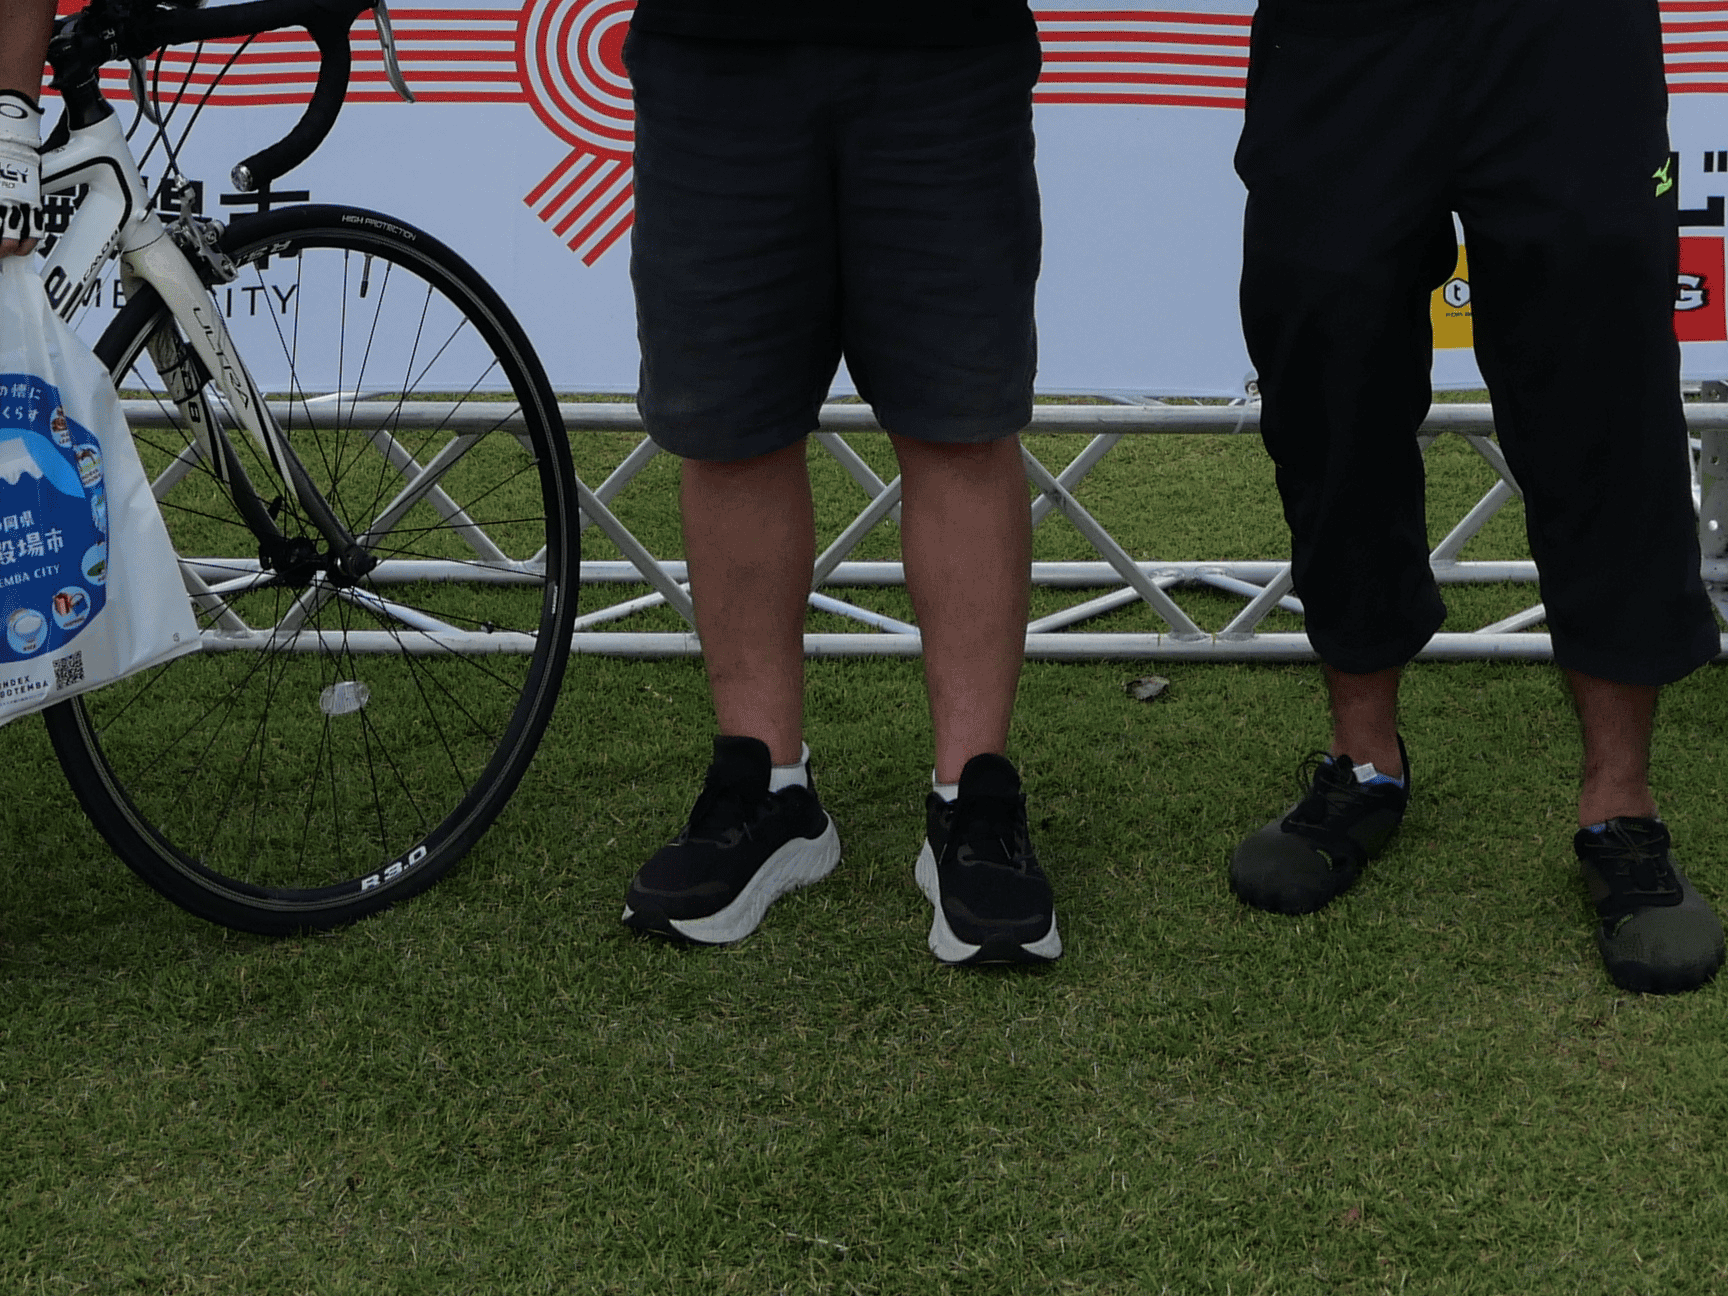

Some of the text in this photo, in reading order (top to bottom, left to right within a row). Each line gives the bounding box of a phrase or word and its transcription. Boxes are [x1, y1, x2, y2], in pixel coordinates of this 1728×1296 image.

[341, 214, 365, 225] HIGH
[226, 283, 300, 319] ITY
[33, 563, 60, 579] CITY
[360, 844, 428, 892] R3.0
